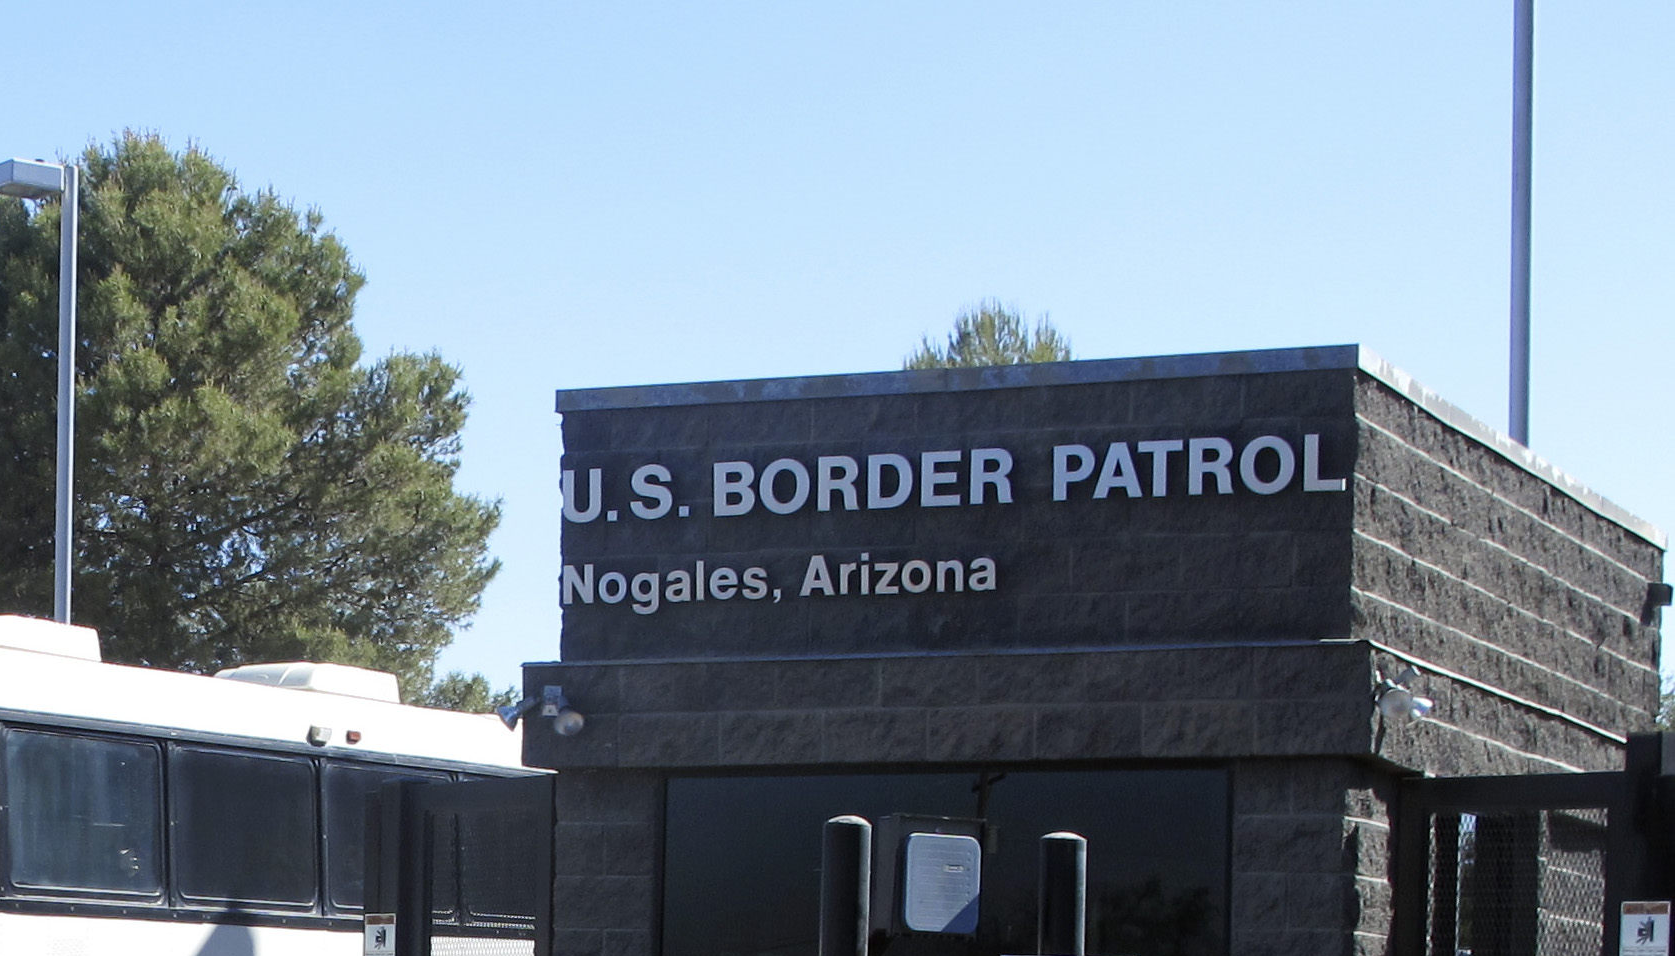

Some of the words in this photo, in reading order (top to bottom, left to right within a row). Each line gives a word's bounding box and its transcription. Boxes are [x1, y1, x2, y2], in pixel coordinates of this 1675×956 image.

[563, 463, 690, 524] U.S.
[713, 447, 1013, 517] BORDER
[1053, 433, 1347, 502] PATROL
[563, 560, 782, 615] Nogales,
[799, 551, 997, 599] Arizona
